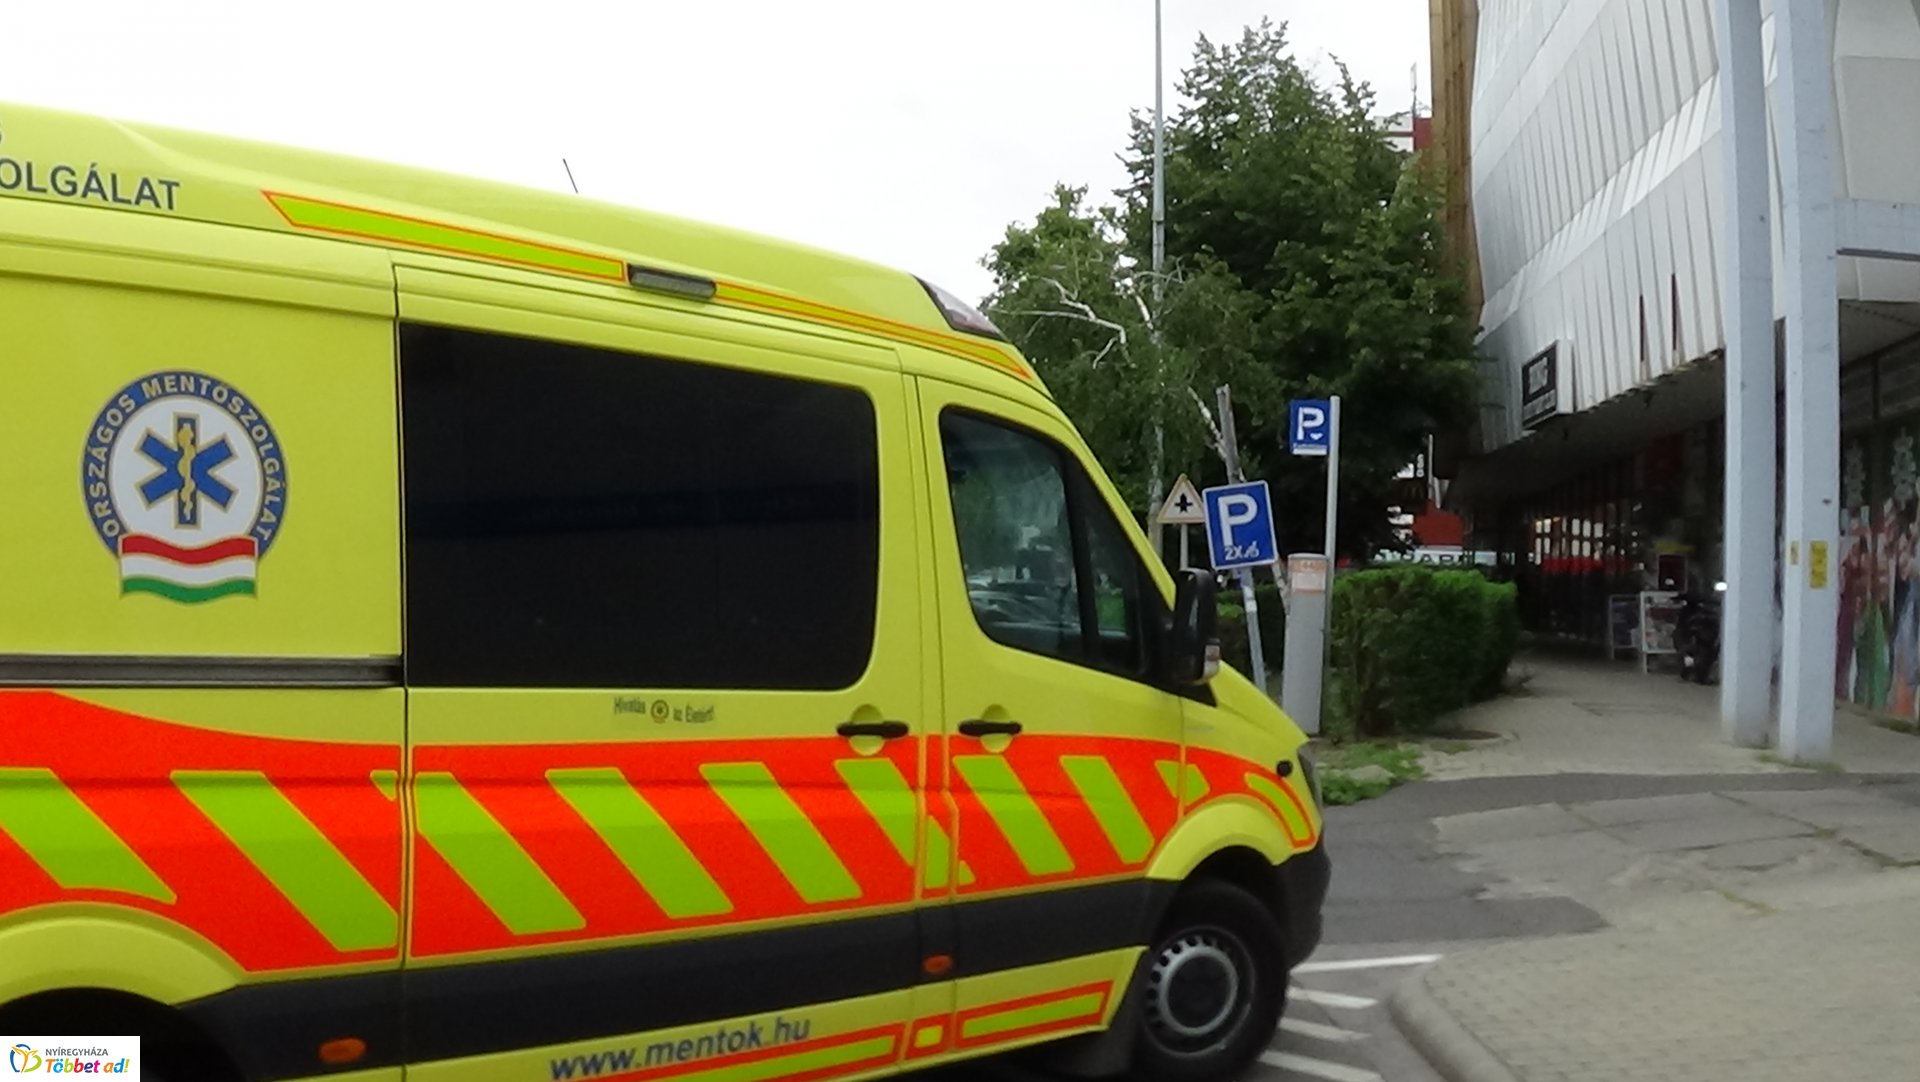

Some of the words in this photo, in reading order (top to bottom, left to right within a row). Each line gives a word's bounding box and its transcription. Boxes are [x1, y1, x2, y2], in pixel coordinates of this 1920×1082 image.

[0, 157, 181, 211] OLGÁLAT
[1297, 406, 1325, 441] P
[87, 392, 136, 539] ORSZÁGOS
[141, 374, 286, 542] MENTŐSZOLGÁLAT
[1217, 493, 1258, 548] P
[550, 1016, 811, 1081] www.mentok.hu
